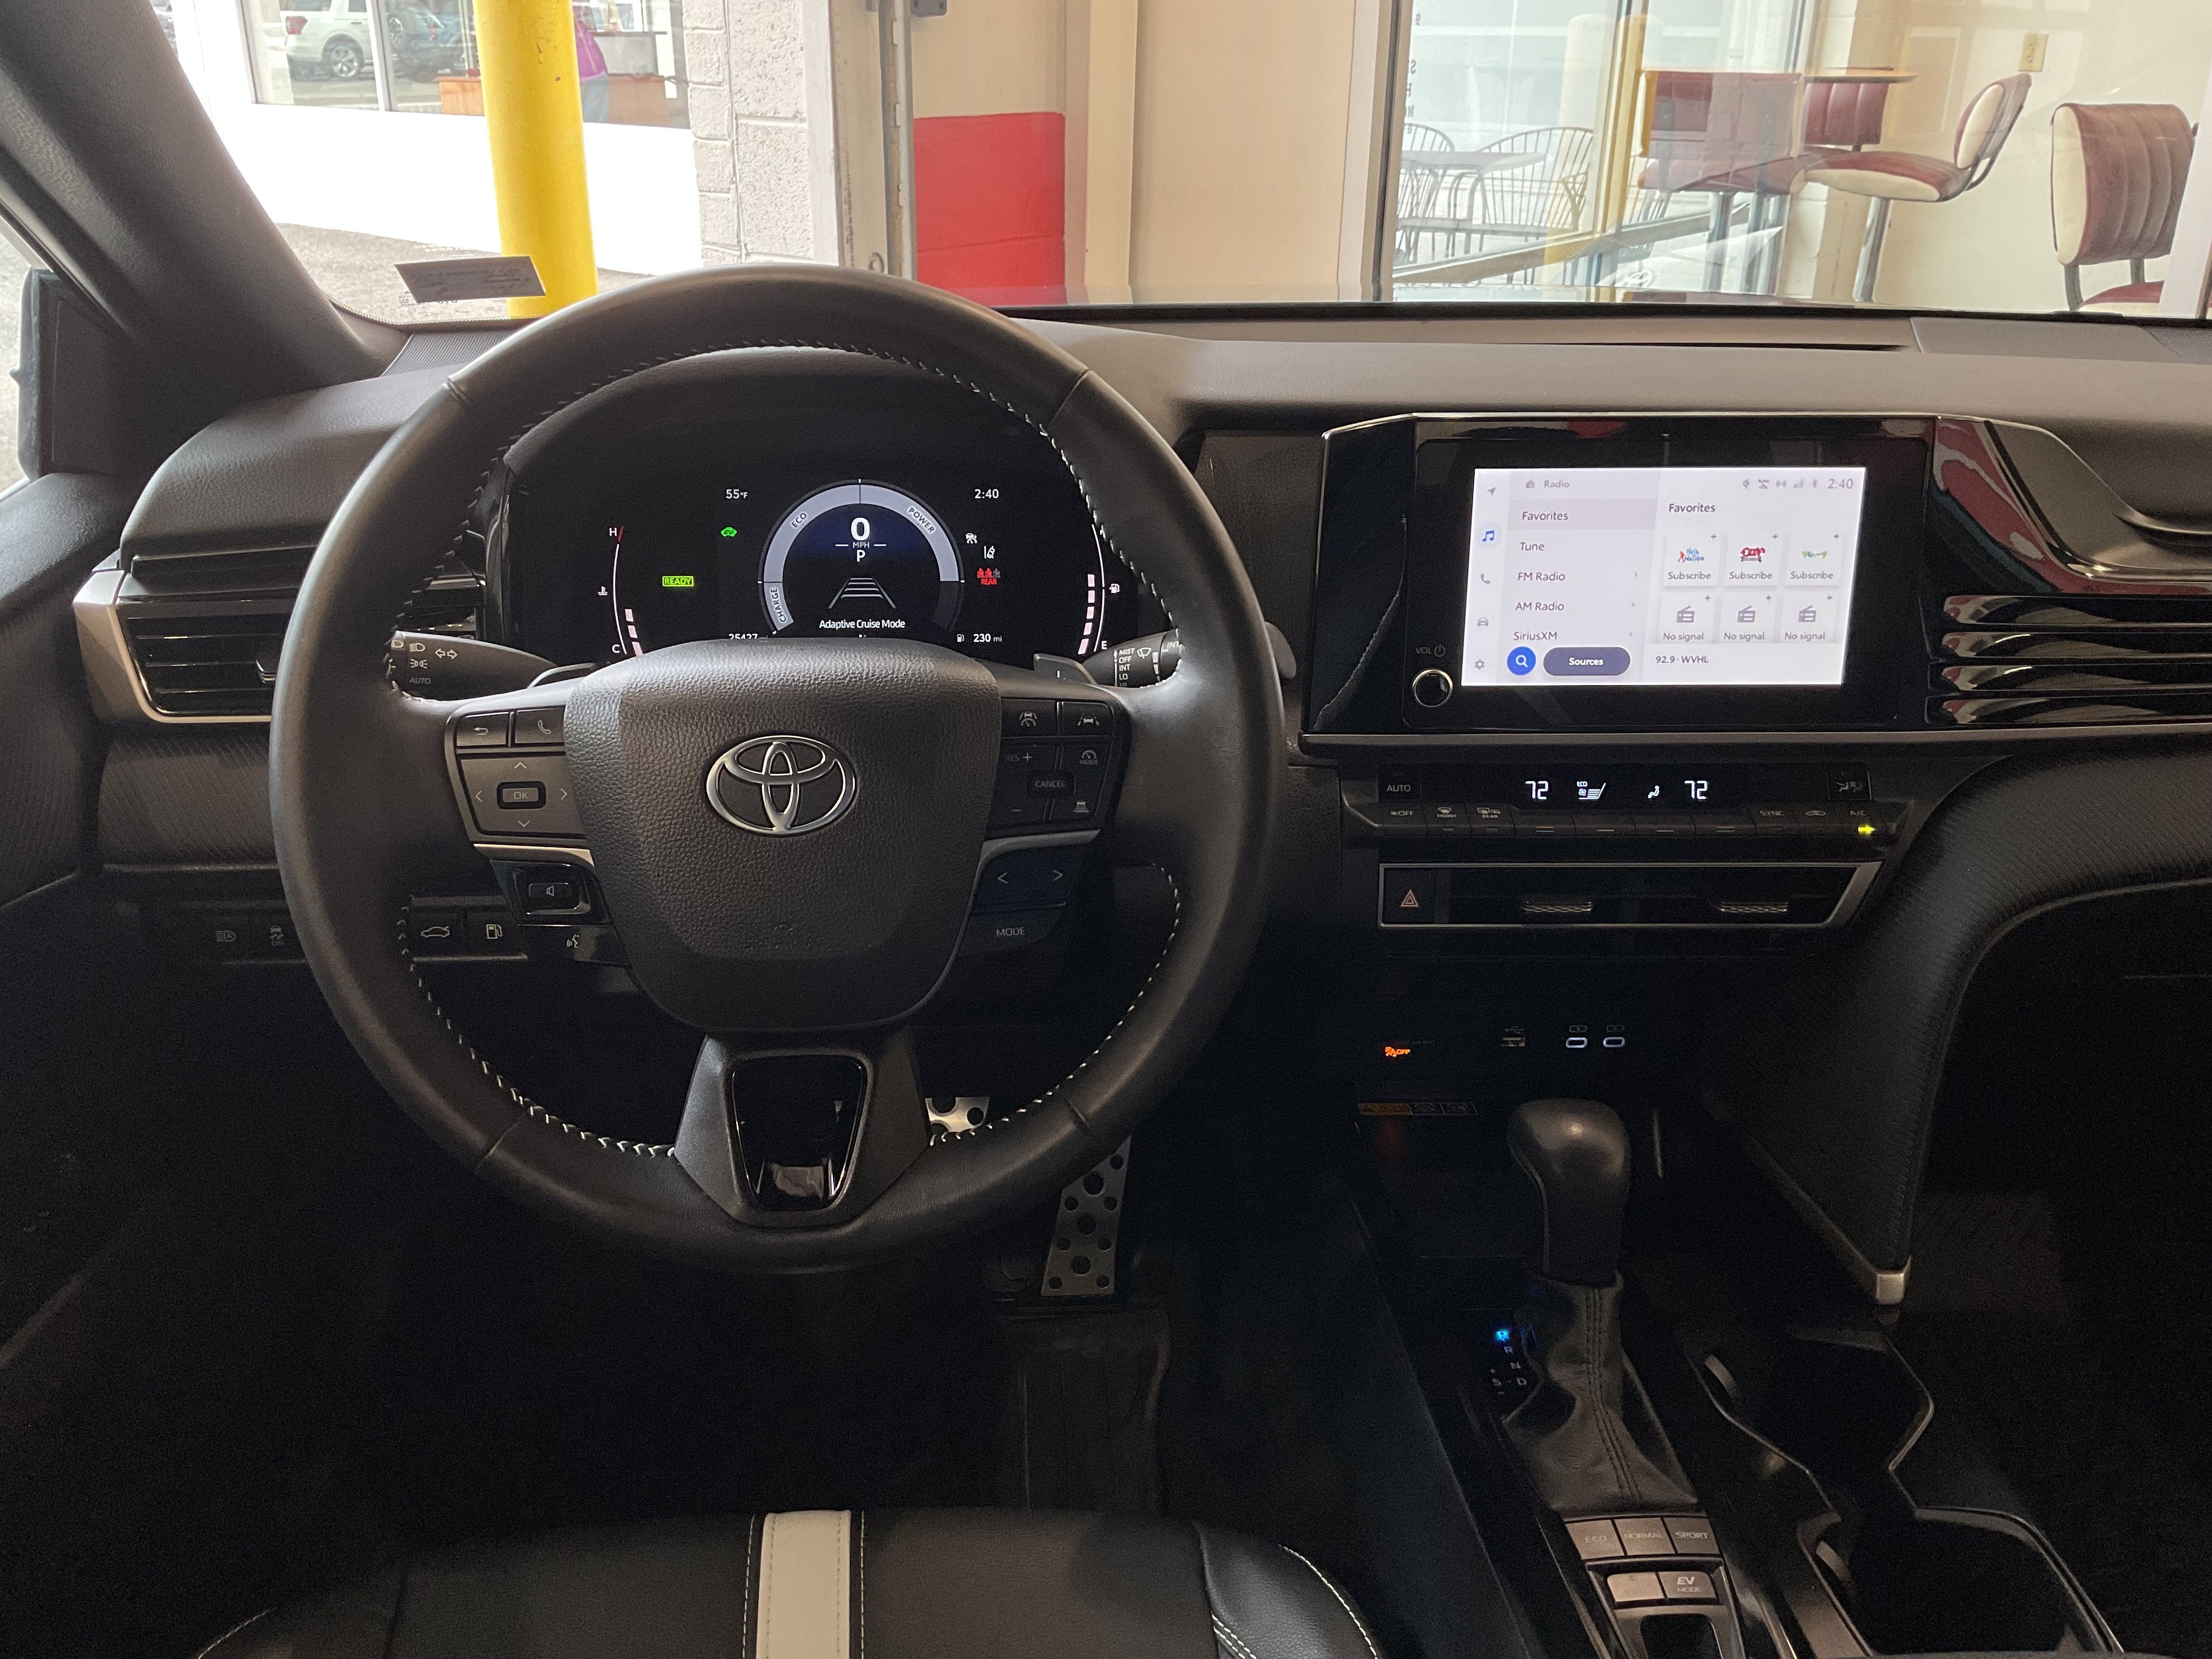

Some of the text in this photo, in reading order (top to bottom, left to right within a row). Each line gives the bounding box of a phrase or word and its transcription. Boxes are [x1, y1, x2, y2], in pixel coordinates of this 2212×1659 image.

[1544, 480, 1570, 488] Radio
[1827, 478, 1853, 489] 2:40
[974, 489, 1000, 499] 2:40
[1668, 503, 1716, 512] Favorites
[791, 512, 807, 528] ECO
[908, 507, 935, 533] POWER
[1522, 511, 1568, 521] Favorites
[609, 527, 617, 537] H
[850, 517, 871, 541] 0
[1520, 542, 1545, 551] Tune
[856, 550, 866, 562] P
[1517, 572, 1565, 582] FM Radio
[1668, 572, 1712, 580] Subscribe
[1729, 572, 1773, 580] Subscribe
[1790, 571, 1833, 579] Subscribe
[770, 587, 787, 623] CHARGE
[1515, 601, 1565, 611] AM Radio
[819, 619, 906, 630] Adaptive Cruise Mode
[973, 634, 991, 642] 230
[1513, 631, 1558, 641] SiriusXM
[1678, 632, 1705, 642] signal
[1739, 632, 1765, 642] signal
[1800, 632, 1826, 642] signal
[612, 644, 620, 653] C
[1101, 640, 1108, 650] E
[1119, 647, 1136, 656] MIST
[1568, 657, 1604, 666] Sources
[1656, 656, 1709, 664] 92.9 WVHL
[1386, 784, 1411, 792] AUTO
[1525, 780, 1549, 800] 72
[1684, 780, 1708, 799] 72
[514, 791, 528, 800] OK
[996, 927, 1025, 936] MODE
[1516, 1378, 1527, 1386] D
[1675, 1531, 1708, 1539] SPORT
[1677, 1577, 1695, 1585] EV
